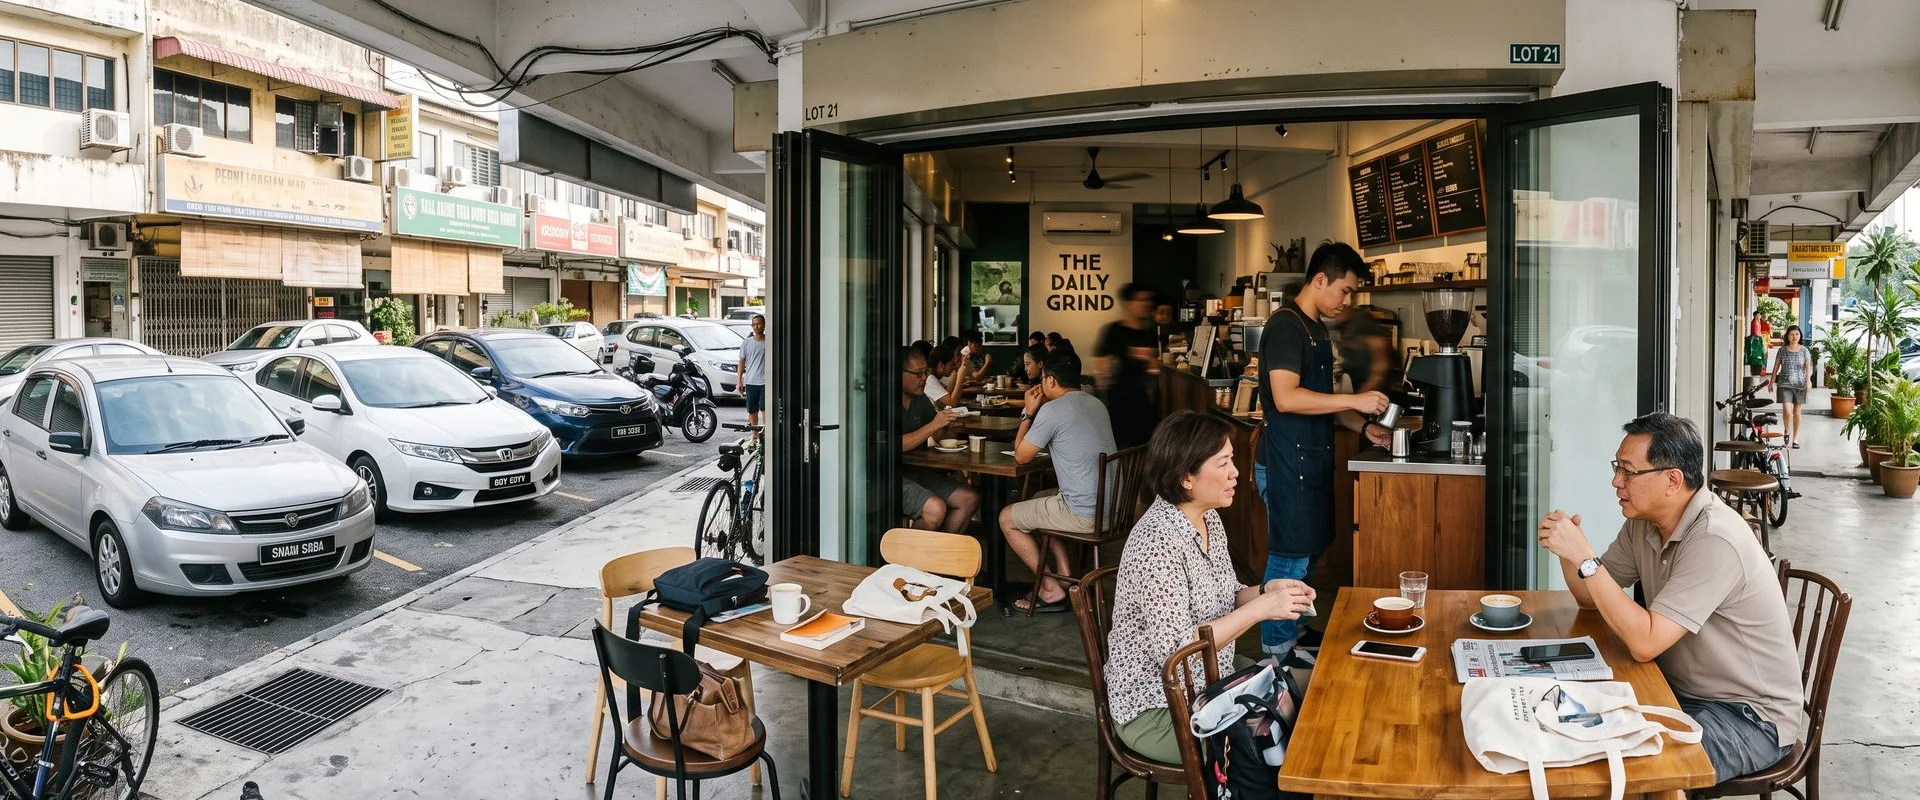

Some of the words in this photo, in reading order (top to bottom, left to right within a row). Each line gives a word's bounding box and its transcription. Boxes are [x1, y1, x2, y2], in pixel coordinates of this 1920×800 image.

[1512, 46, 1540, 62] LOT
[1543, 46, 1558, 62] 21
[805, 105, 825, 121] LOT
[827, 103, 838, 118] 21
[1059, 254, 1102, 271] THE
[1051, 274, 1110, 291] DAILY
[1046, 294, 1115, 311] GRIND
